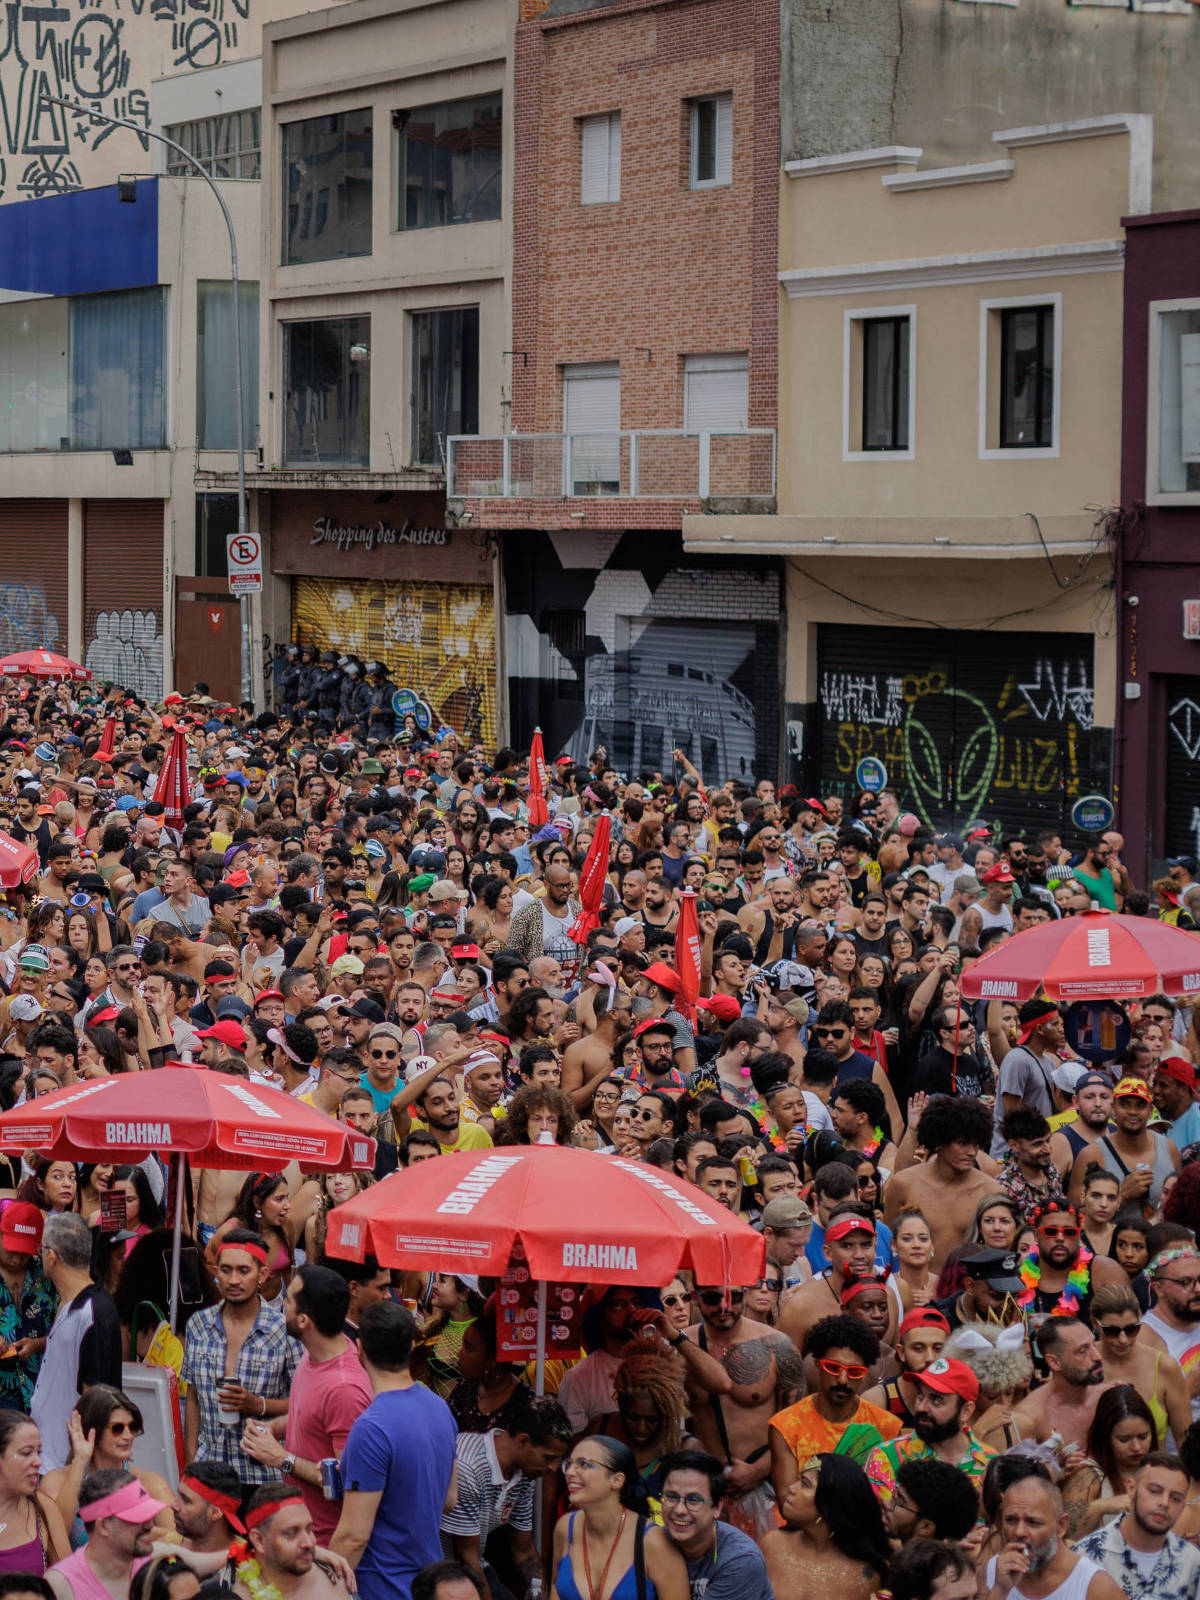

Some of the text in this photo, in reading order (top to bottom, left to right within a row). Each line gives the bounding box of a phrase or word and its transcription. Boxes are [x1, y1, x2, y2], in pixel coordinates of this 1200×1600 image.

[310, 517, 447, 550] Shopping dos Lustres
[980, 981, 1019, 998] BRAHMA
[415, 1060, 429, 1071] NY
[105, 1122, 172, 1146] BRAHMA
[436, 1154, 526, 1215] BRAHMA
[562, 1243, 638, 1271] BRAHMA
